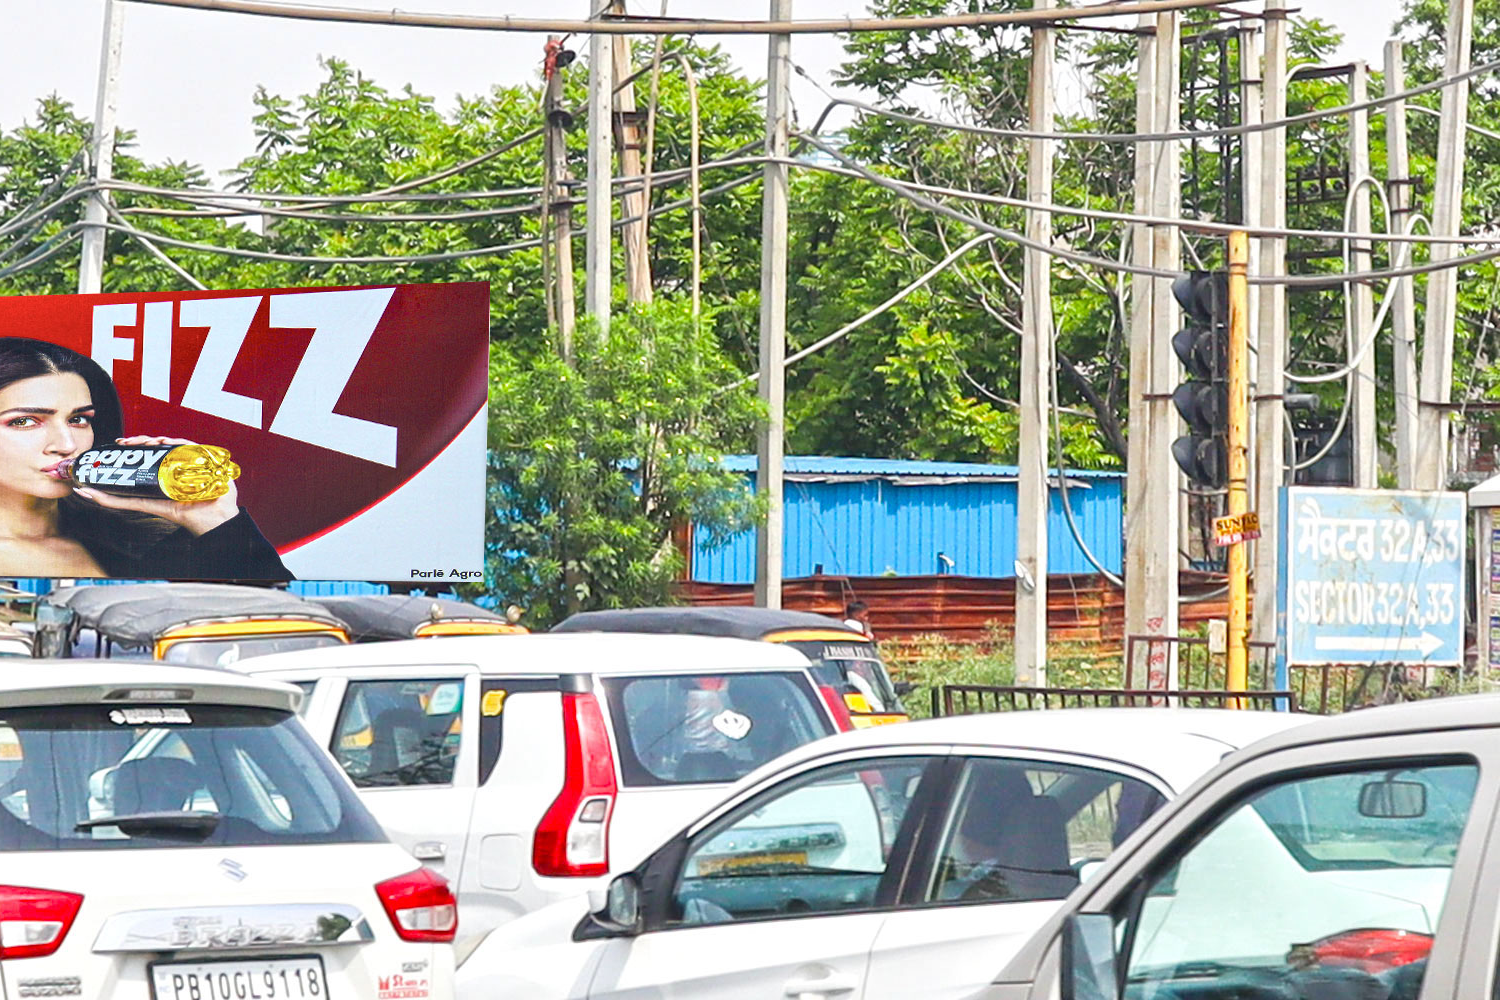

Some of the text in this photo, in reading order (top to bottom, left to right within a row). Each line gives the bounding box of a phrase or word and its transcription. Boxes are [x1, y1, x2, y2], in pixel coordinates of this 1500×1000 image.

[90, 287, 398, 468] FIZZ
[79, 449, 168, 470] appy
[76, 461, 138, 486] fizz
[449, 568, 482, 580] Agro
[1295, 580, 1376, 626] SECTOR
